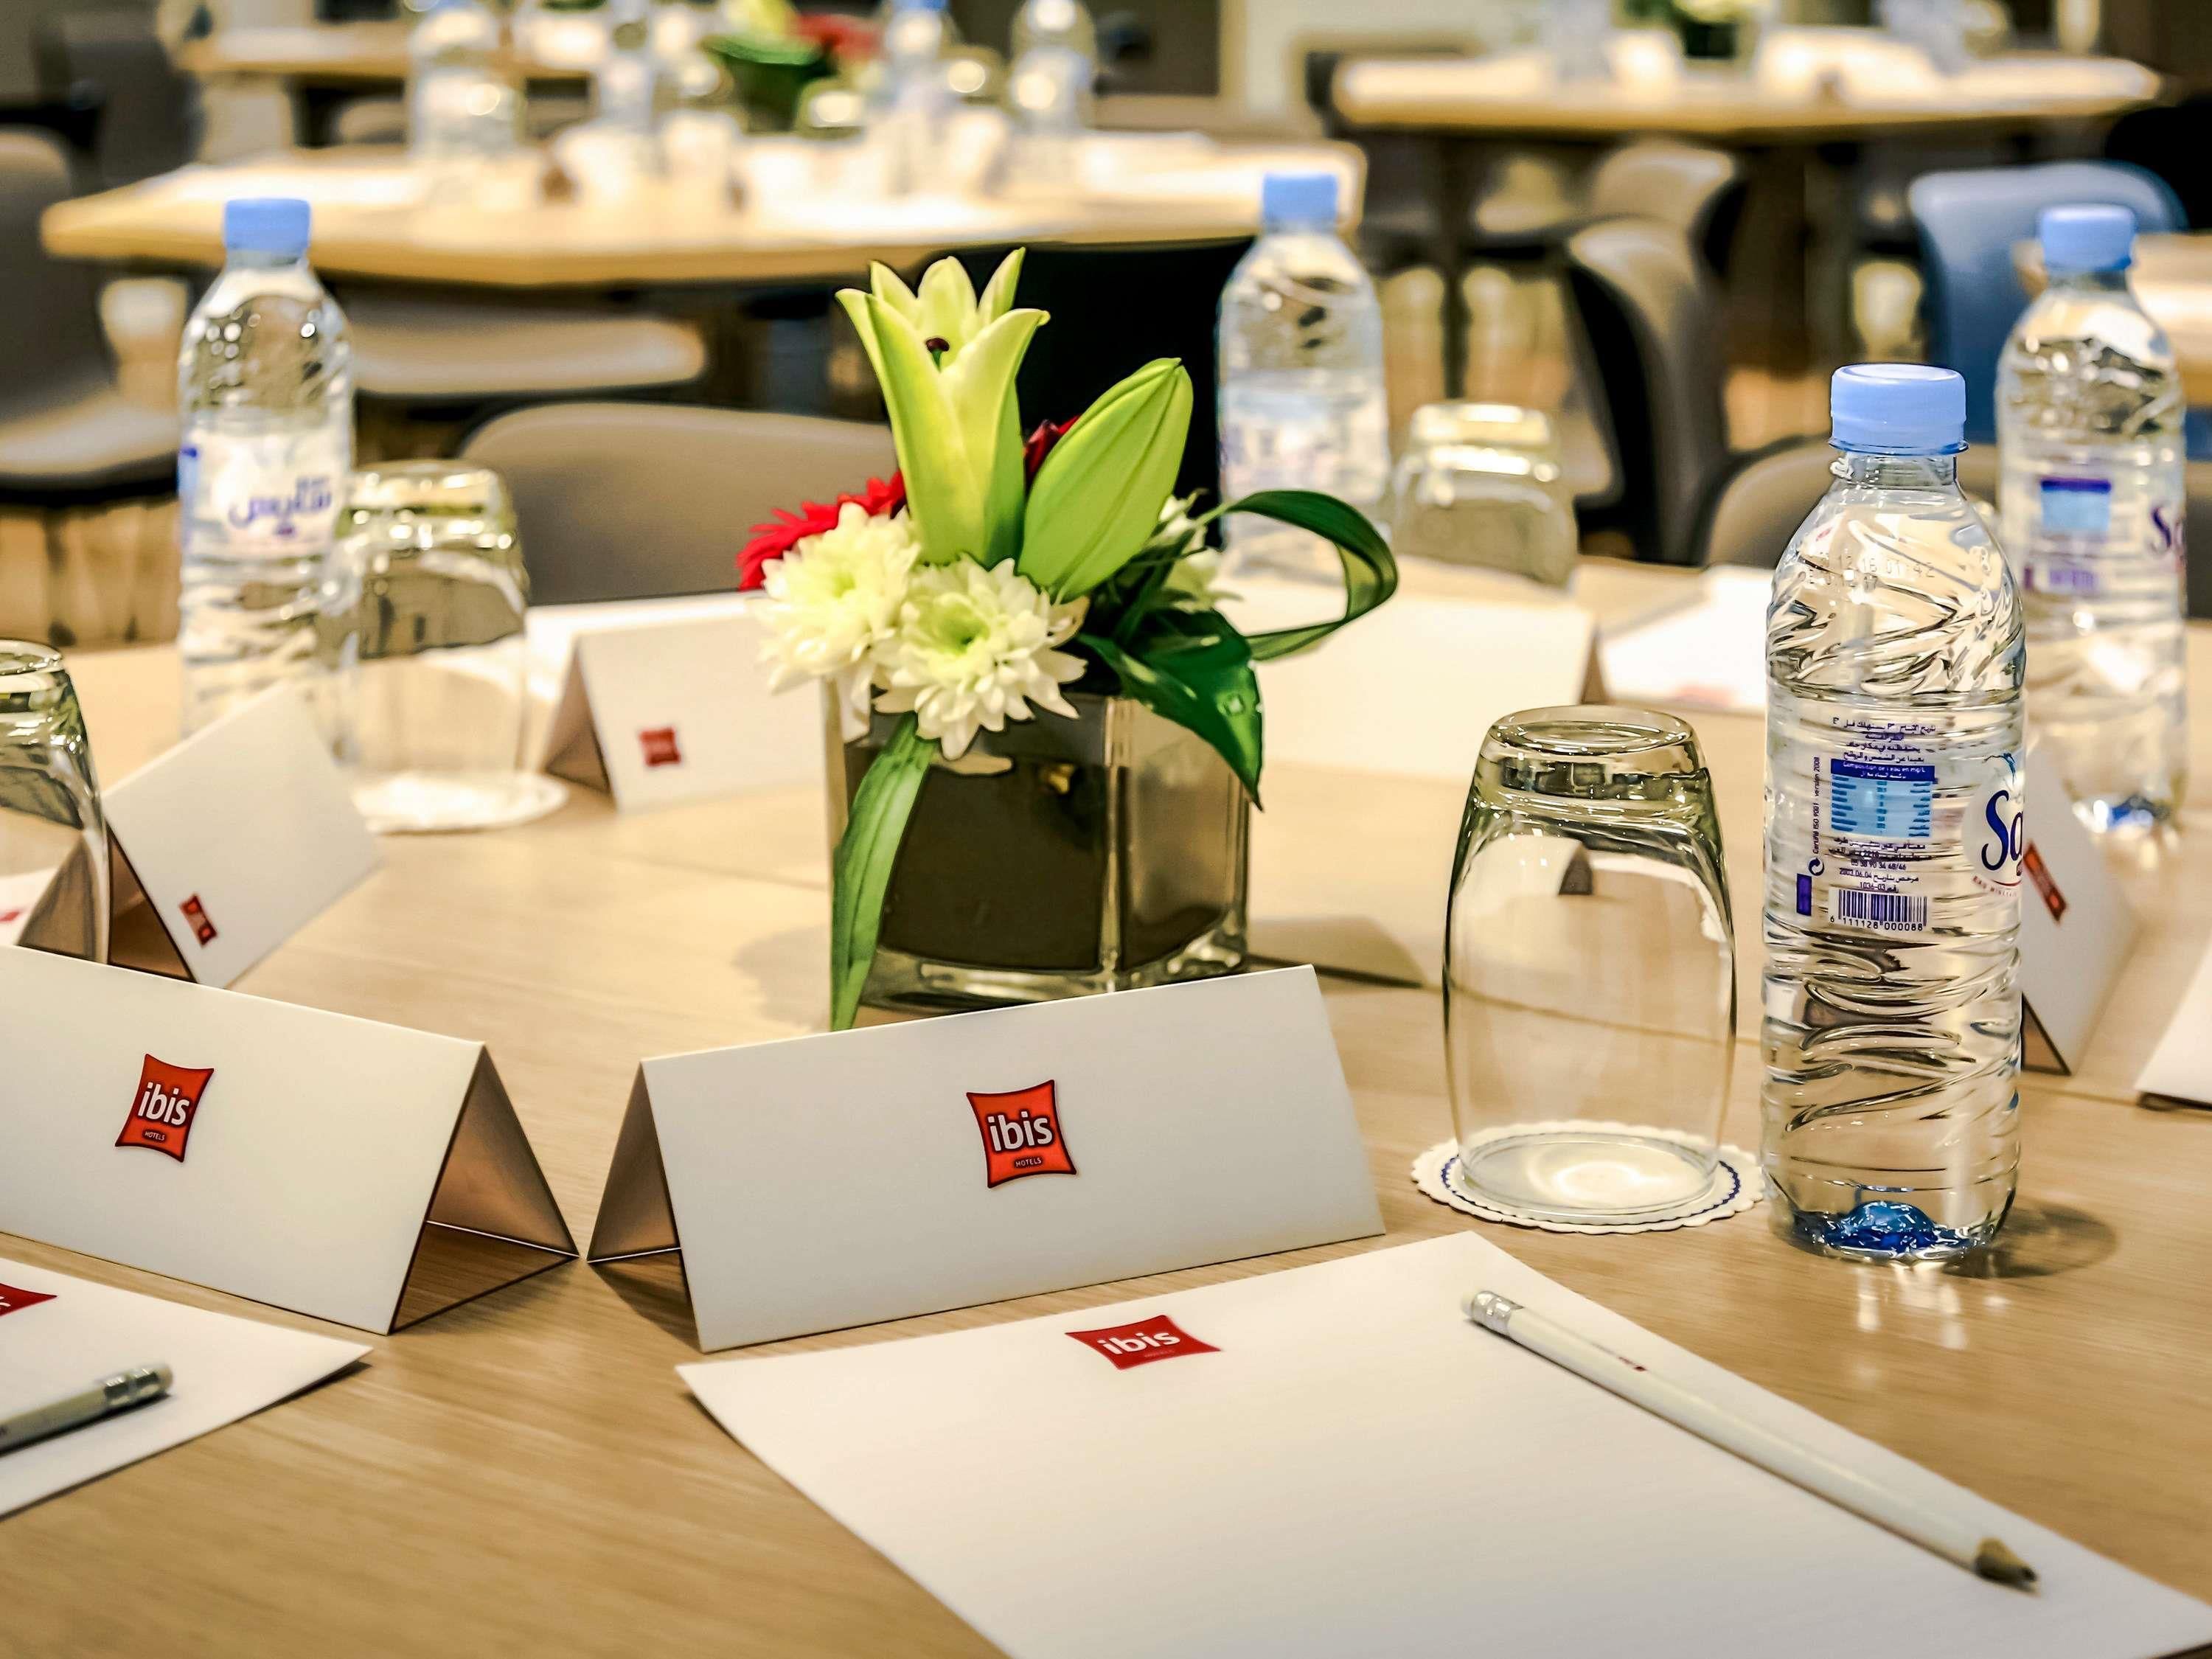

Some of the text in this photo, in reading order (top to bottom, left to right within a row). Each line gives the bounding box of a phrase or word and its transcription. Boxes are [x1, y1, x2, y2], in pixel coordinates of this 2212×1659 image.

[1830, 915, 1924, 931] 6 111128 000088
[138, 1082, 190, 1126] ibis
[145, 1130, 166, 1141] HOTELS
[987, 1110, 1053, 1152] ibis
[1015, 1157, 1042, 1167] HOTELS
[1096, 1332, 1180, 1354] ibis
